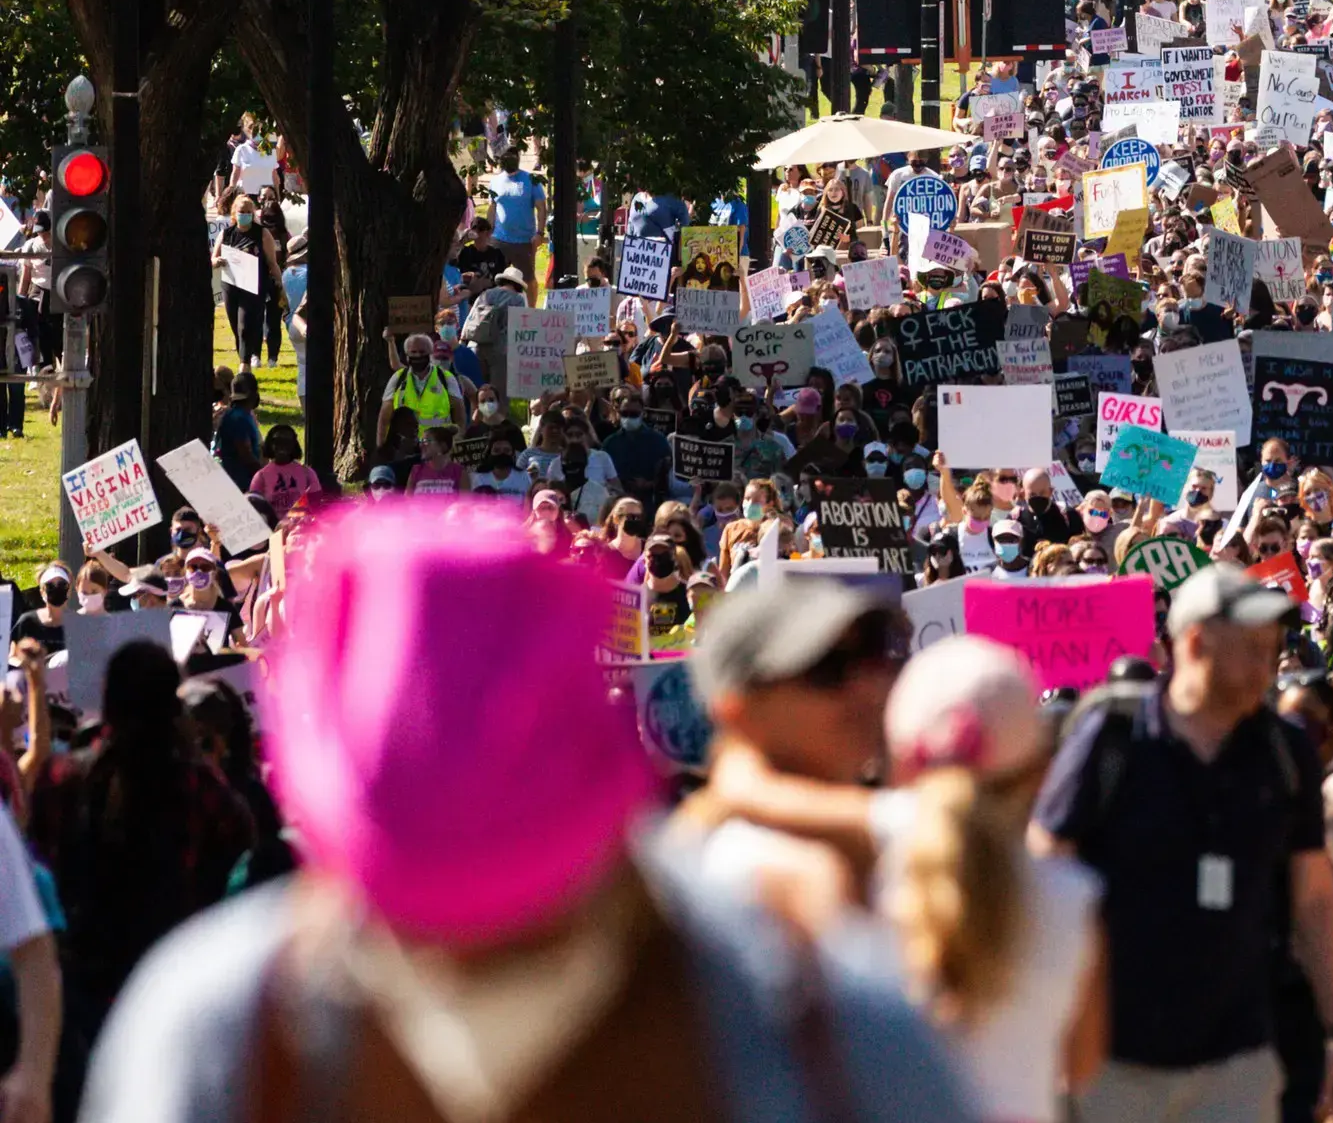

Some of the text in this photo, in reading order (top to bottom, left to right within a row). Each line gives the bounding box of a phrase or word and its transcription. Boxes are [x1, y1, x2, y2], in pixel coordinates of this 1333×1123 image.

[1163, 50, 1172, 63] IF
[1182, 49, 1213, 61] WANTED
[1121, 72, 1136, 90] I
[1173, 82, 1201, 96] PUSSY
[1196, 94, 1216, 105] FUCK
[1112, 144, 1148, 159] KEEP
[907, 179, 944, 195] KEEP
[898, 195, 953, 211] ABORTION
[625, 236, 670, 257] I AM A
[941, 232, 963, 249] BANS
[1031, 234, 1070, 244] KEEP YOUR
[934, 242, 966, 258] OFF MY
[1032, 244, 1052, 252] LAWS
[627, 252, 664, 268] WOMAN
[935, 252, 959, 266] BODY
[1033, 253, 1045, 261] MY
[630, 267, 657, 280] NOT A
[624, 278, 658, 294] WOMB
[677, 290, 717, 306] PROTECT
[540, 314, 566, 326] WILL
[515, 330, 564, 343] NOT GO
[736, 328, 784, 344] Grow
[1009, 324, 1045, 338] RUTH
[930, 330, 979, 354] THE
[517, 345, 567, 357] QUIETLY
[904, 346, 1001, 385] PATRIARCHY
[1102, 397, 1160, 426] GIRLS
[679, 441, 725, 455] KEEP YOUR
[681, 453, 724, 466] LAWS OFF
[67, 447, 133, 492] IF MY
[683, 467, 721, 477] MY BODY
[72, 463, 144, 506] VAGINA
[77, 499, 110, 519] FIRED
[820, 501, 900, 527] ABORTION
[85, 501, 157, 545] REGULATE IT
[853, 527, 869, 547] IS
[1122, 541, 1198, 587] ERA
[1016, 594, 1107, 630] MORE
[1103, 636, 1128, 660] A
